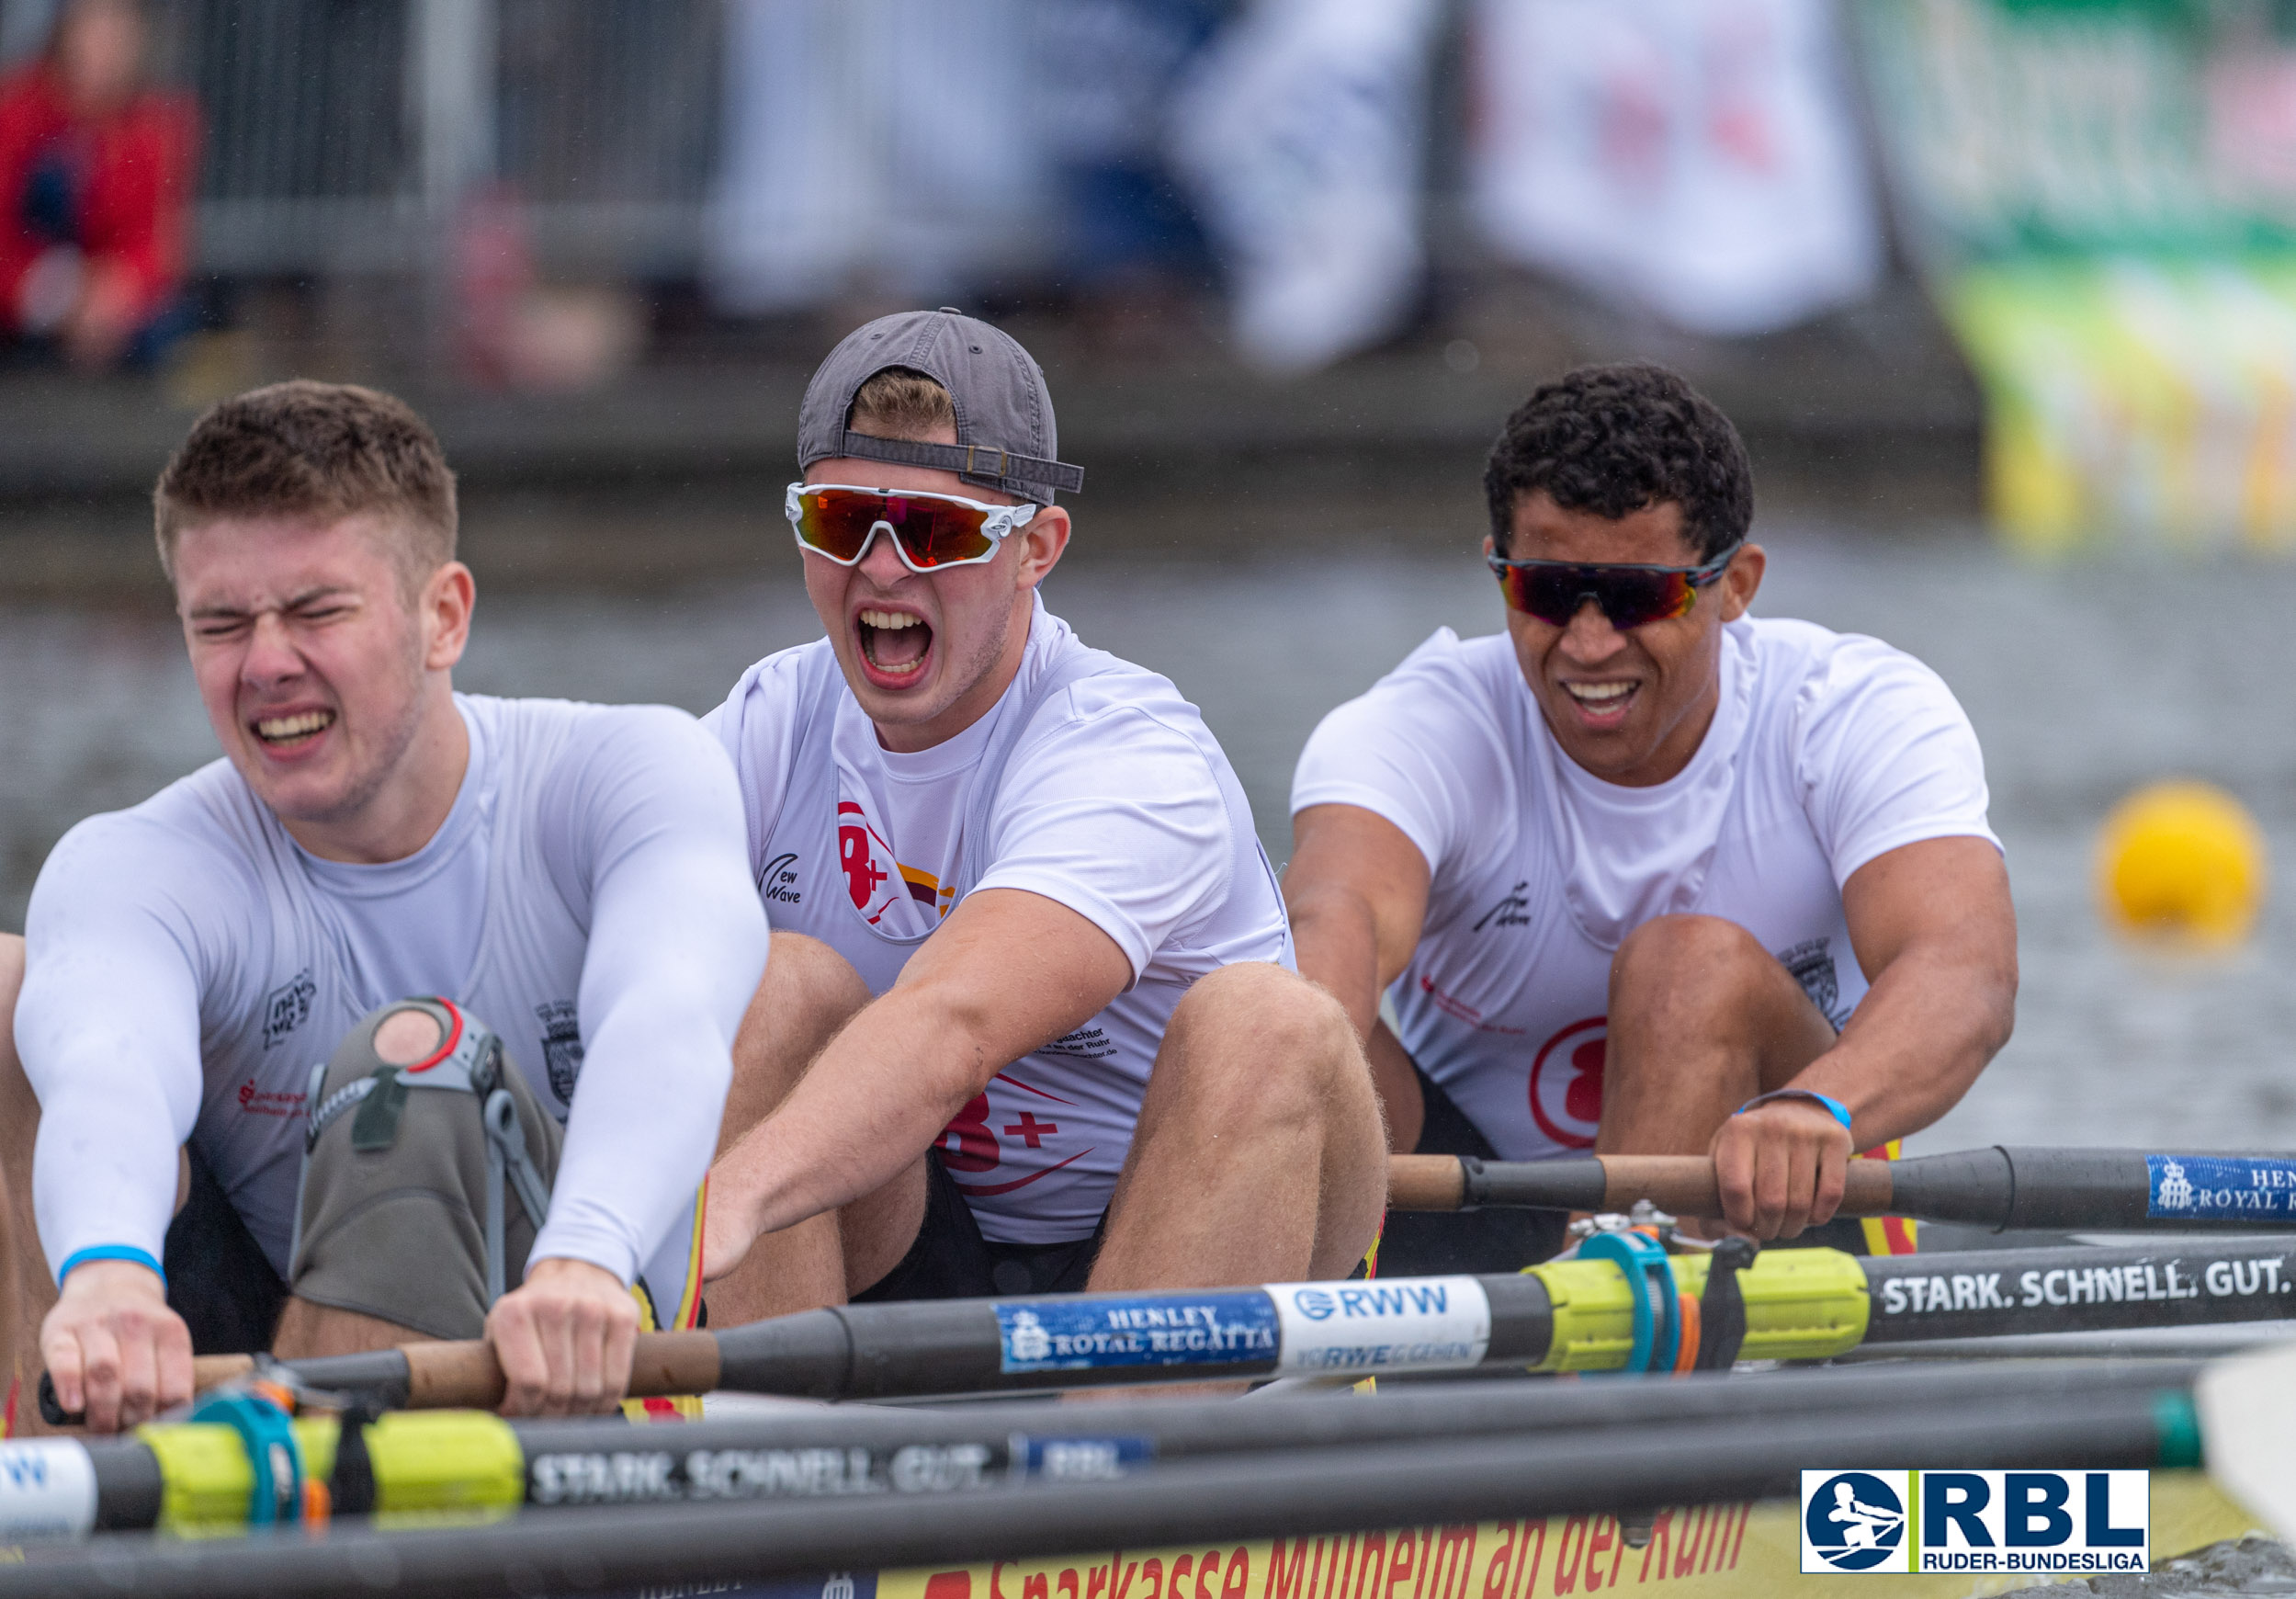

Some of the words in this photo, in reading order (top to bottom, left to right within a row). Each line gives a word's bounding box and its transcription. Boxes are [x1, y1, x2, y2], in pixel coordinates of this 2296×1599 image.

[1085, 1038, 1111, 1049] Ruhr
[2200, 1188, 2278, 1209] ROYAL
[1884, 1274, 2015, 1314] STARK.
[2021, 1264, 2199, 1308] SCHNELL.
[2205, 1259, 2292, 1297] GUT.
[1338, 1285, 1447, 1317] RWW
[1108, 1306, 1216, 1329] HENLEY
[1057, 1333, 1145, 1355] ROYAL
[1150, 1326, 1274, 1352] REGATTA
